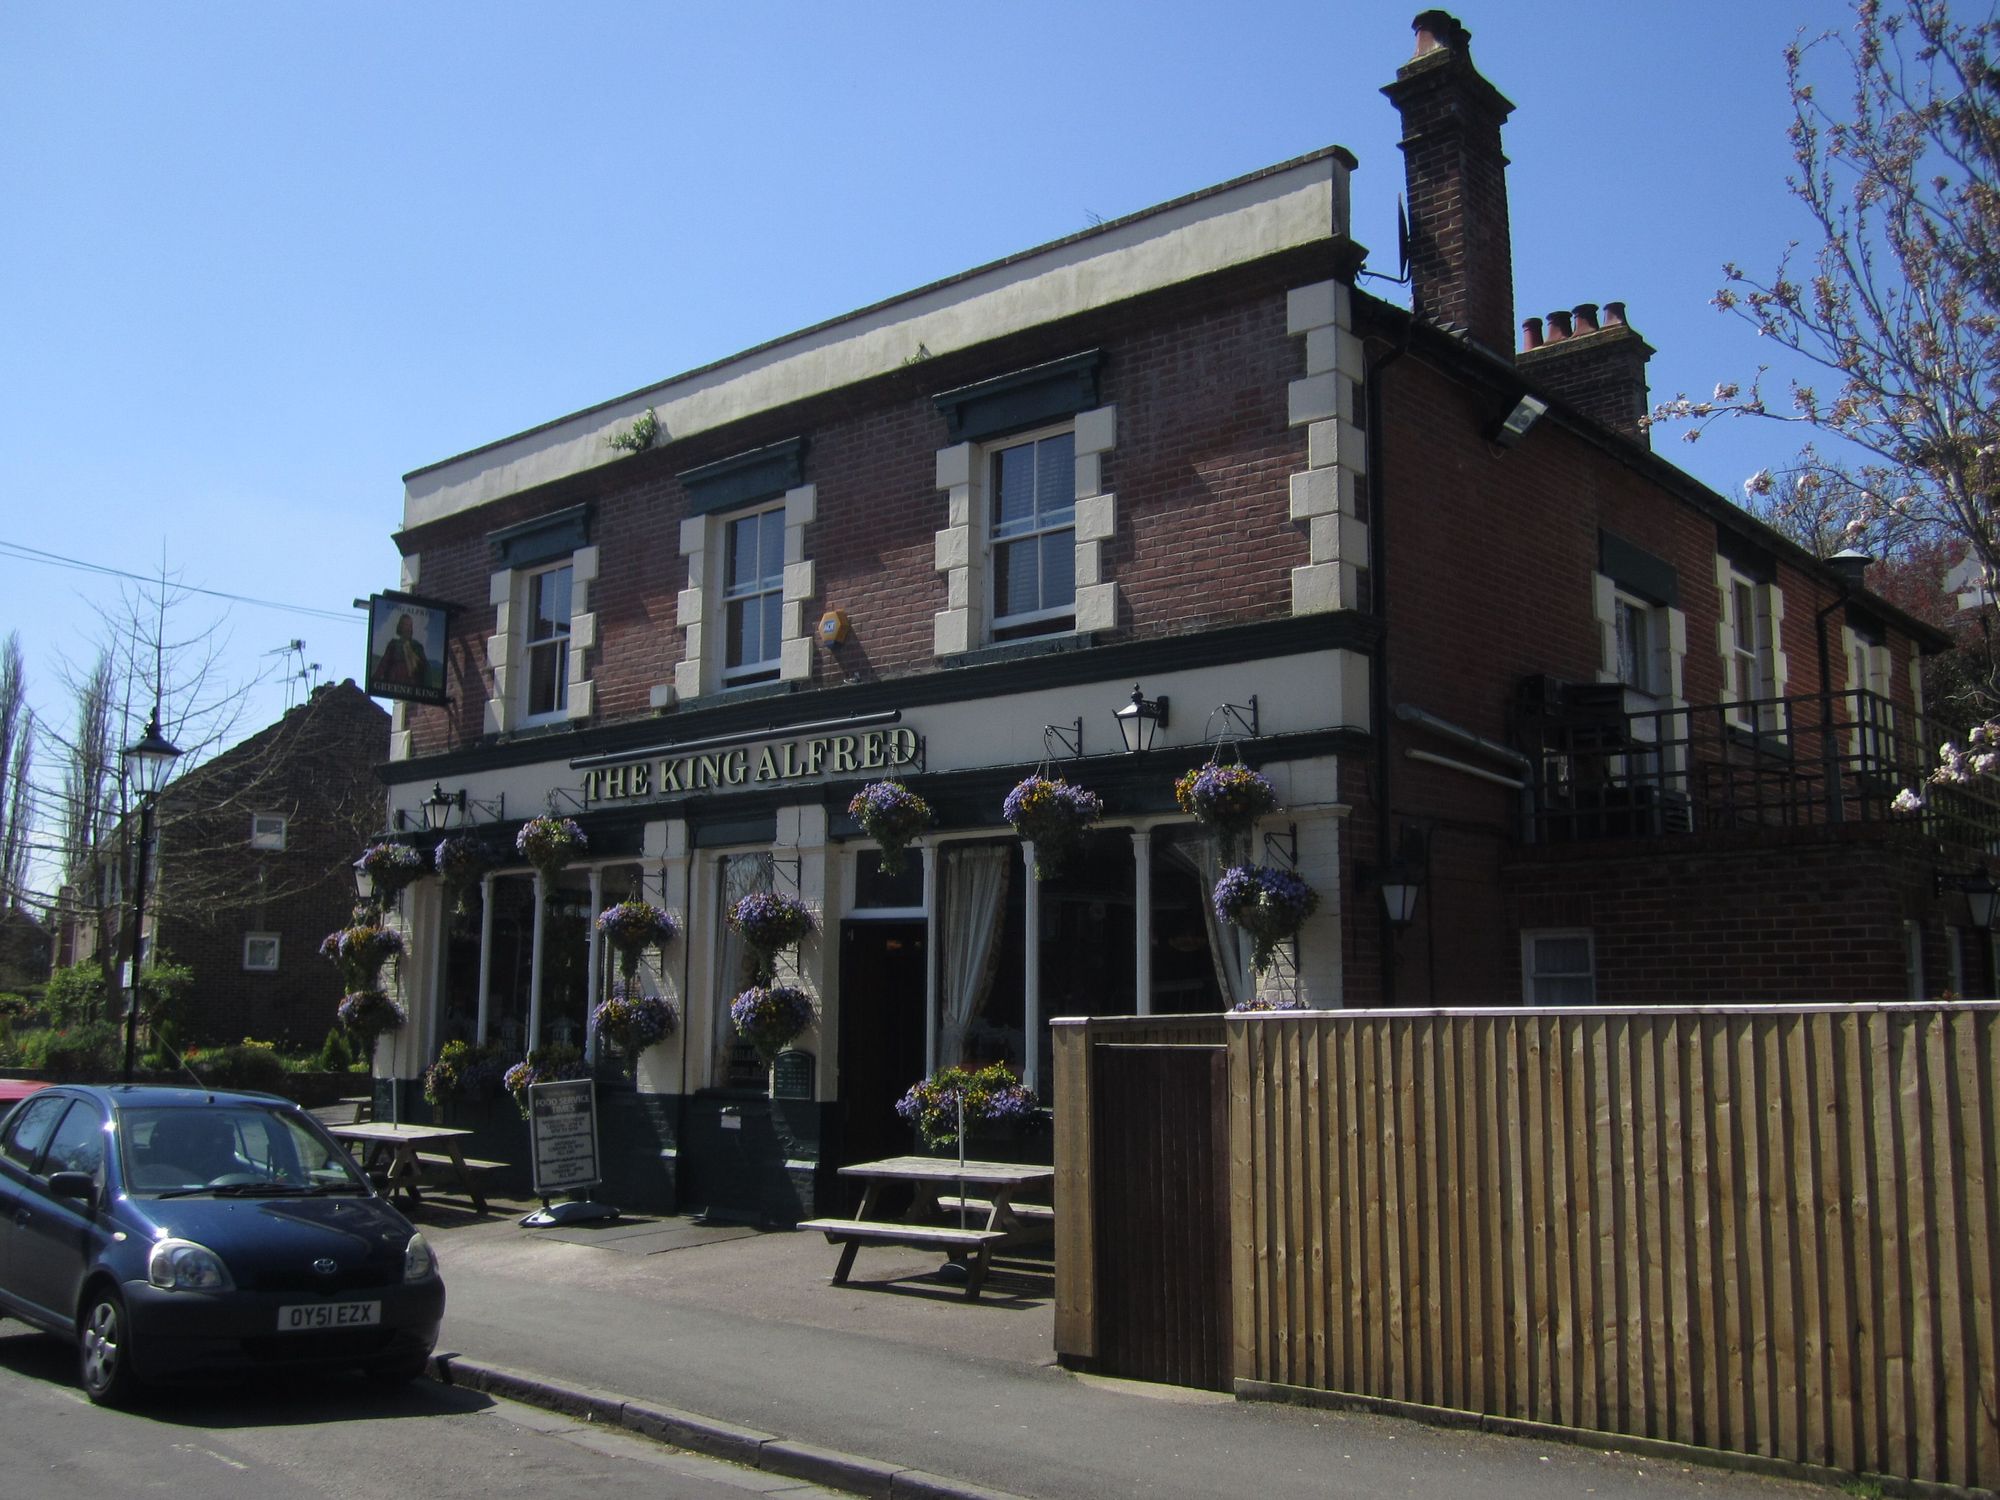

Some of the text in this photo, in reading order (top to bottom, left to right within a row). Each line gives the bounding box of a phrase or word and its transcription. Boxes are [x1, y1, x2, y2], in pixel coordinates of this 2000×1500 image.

[373, 682, 438, 698] GREENE KING
[585, 728, 918, 800] THE KING ALFRED
[535, 1095, 590, 1108] FOOD SERVICE
[552, 1105, 576, 1113] TIMES
[291, 1304, 372, 1327] OY51 EZX
